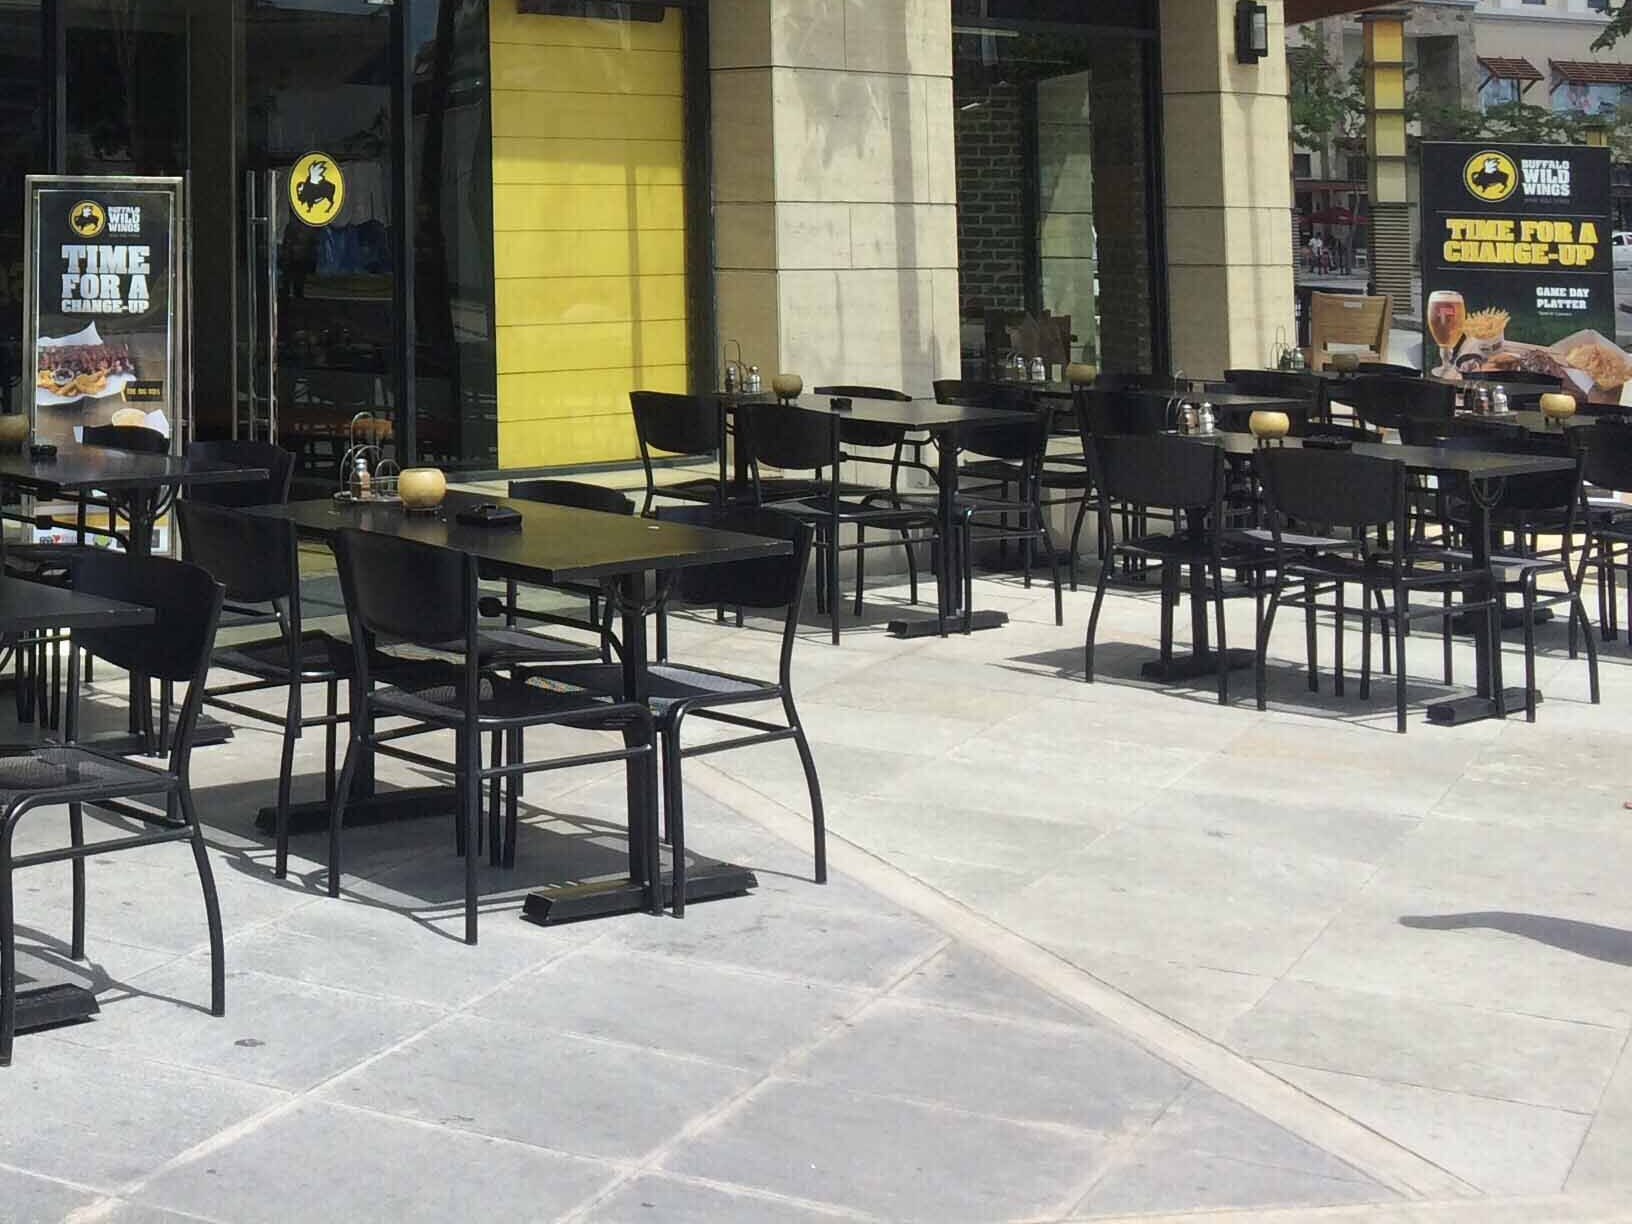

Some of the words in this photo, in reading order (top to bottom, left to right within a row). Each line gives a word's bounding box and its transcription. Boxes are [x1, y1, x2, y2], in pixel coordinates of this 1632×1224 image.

[1521, 159, 1570, 170] BUFFALO
[1523, 169, 1570, 184] WILD
[1523, 183, 1571, 197] WINGS
[108, 213, 141, 224] WILD
[1446, 218, 1515, 241] TIME
[1520, 220, 1574, 243] FOR
[1578, 222, 1599, 244] A
[61, 244, 151, 275] TIME
[1443, 240, 1595, 266] CHANGE-UP
[61, 274, 121, 300] FOR
[129, 276, 150, 300] A
[1536, 286, 1567, 297] GAME
[1569, 287, 1590, 298] DAY
[61, 299, 150, 314] CHANGE-UP
[1536, 298, 1587, 309] PLATTER
